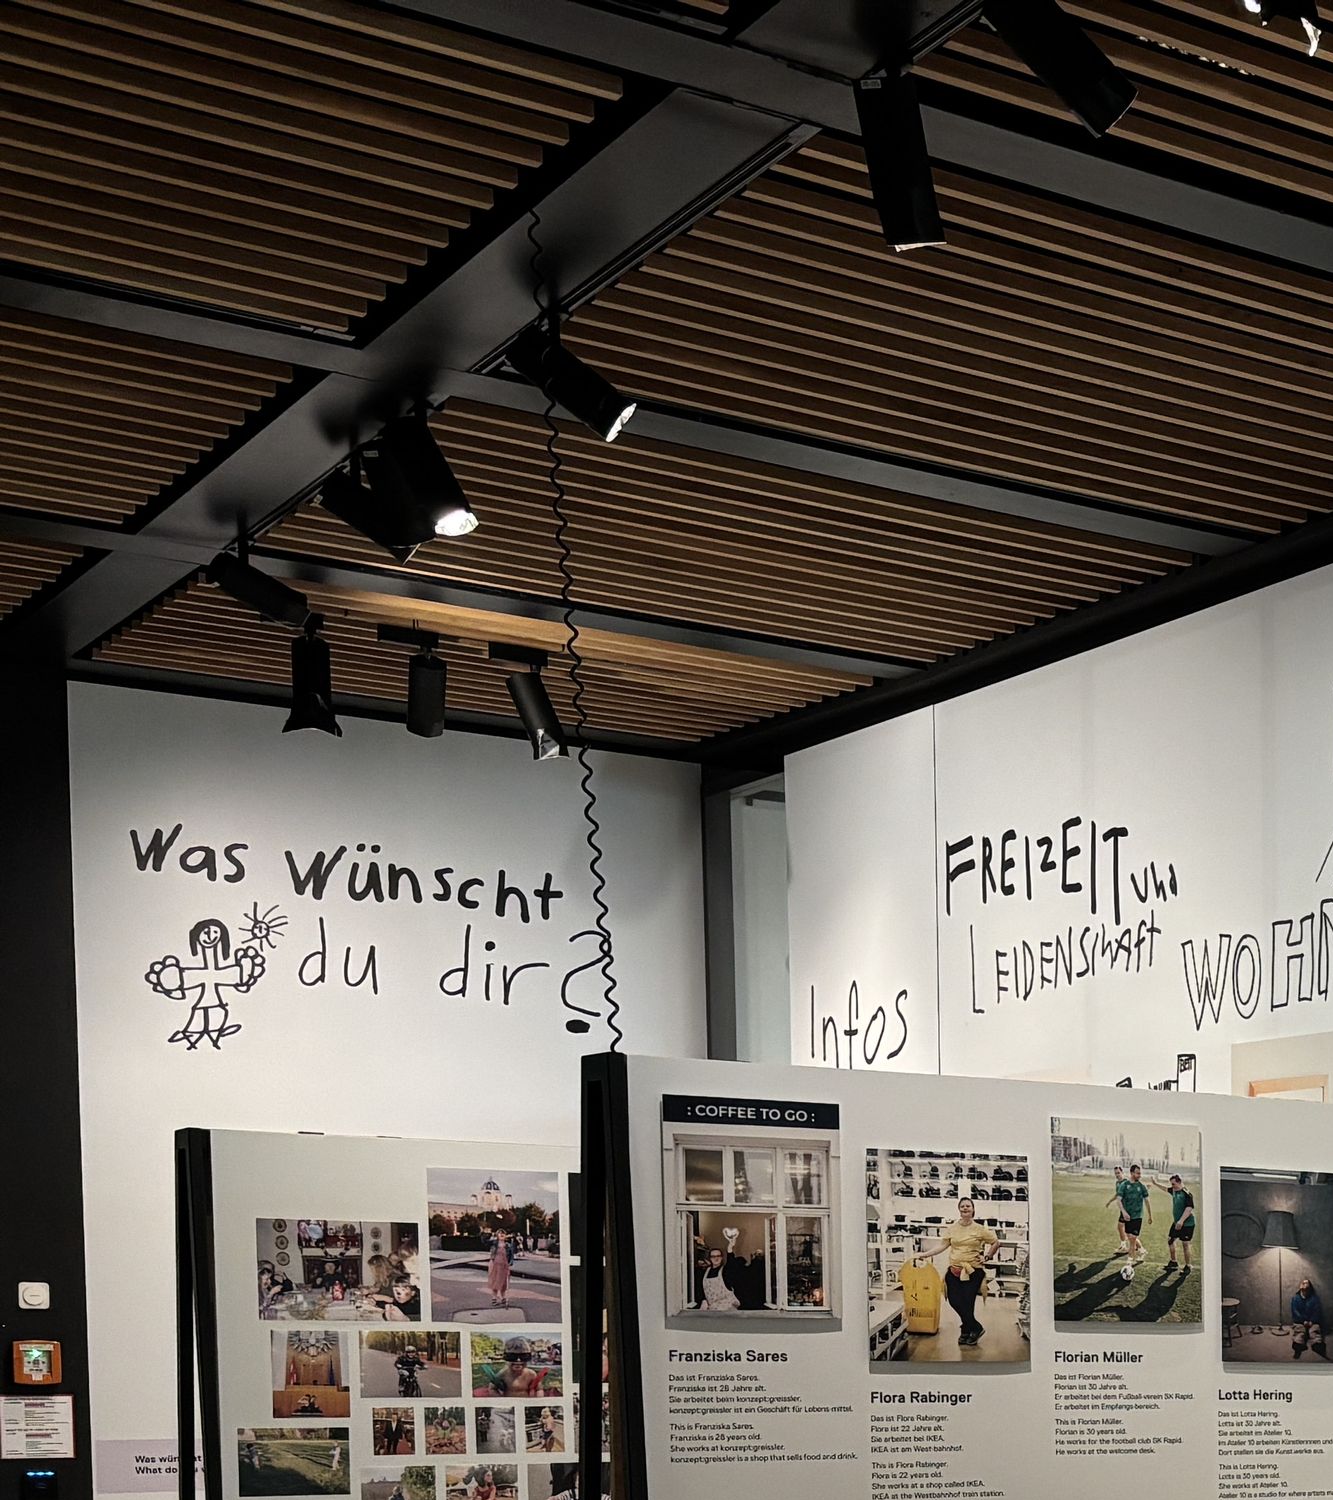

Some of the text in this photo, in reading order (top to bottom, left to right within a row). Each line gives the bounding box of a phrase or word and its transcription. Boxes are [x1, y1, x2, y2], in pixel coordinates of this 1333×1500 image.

[130, 824, 248, 883] Was
[945, 816, 1129, 926] FREIZEIT
[299, 917, 378, 995] du
[811, 980, 908, 1068] Infos
[695, 1104, 808, 1122] COFFEE TO GO
[669, 1350, 788, 1362] Franziska Sares
[1054, 1351, 1143, 1363] Florian Müller
[871, 1391, 972, 1406] Flora Rabinger
[1218, 1389, 1293, 1403] Lotta Hering
[135, 1455, 156, 1463] Was
[135, 1466, 178, 1474] What do
